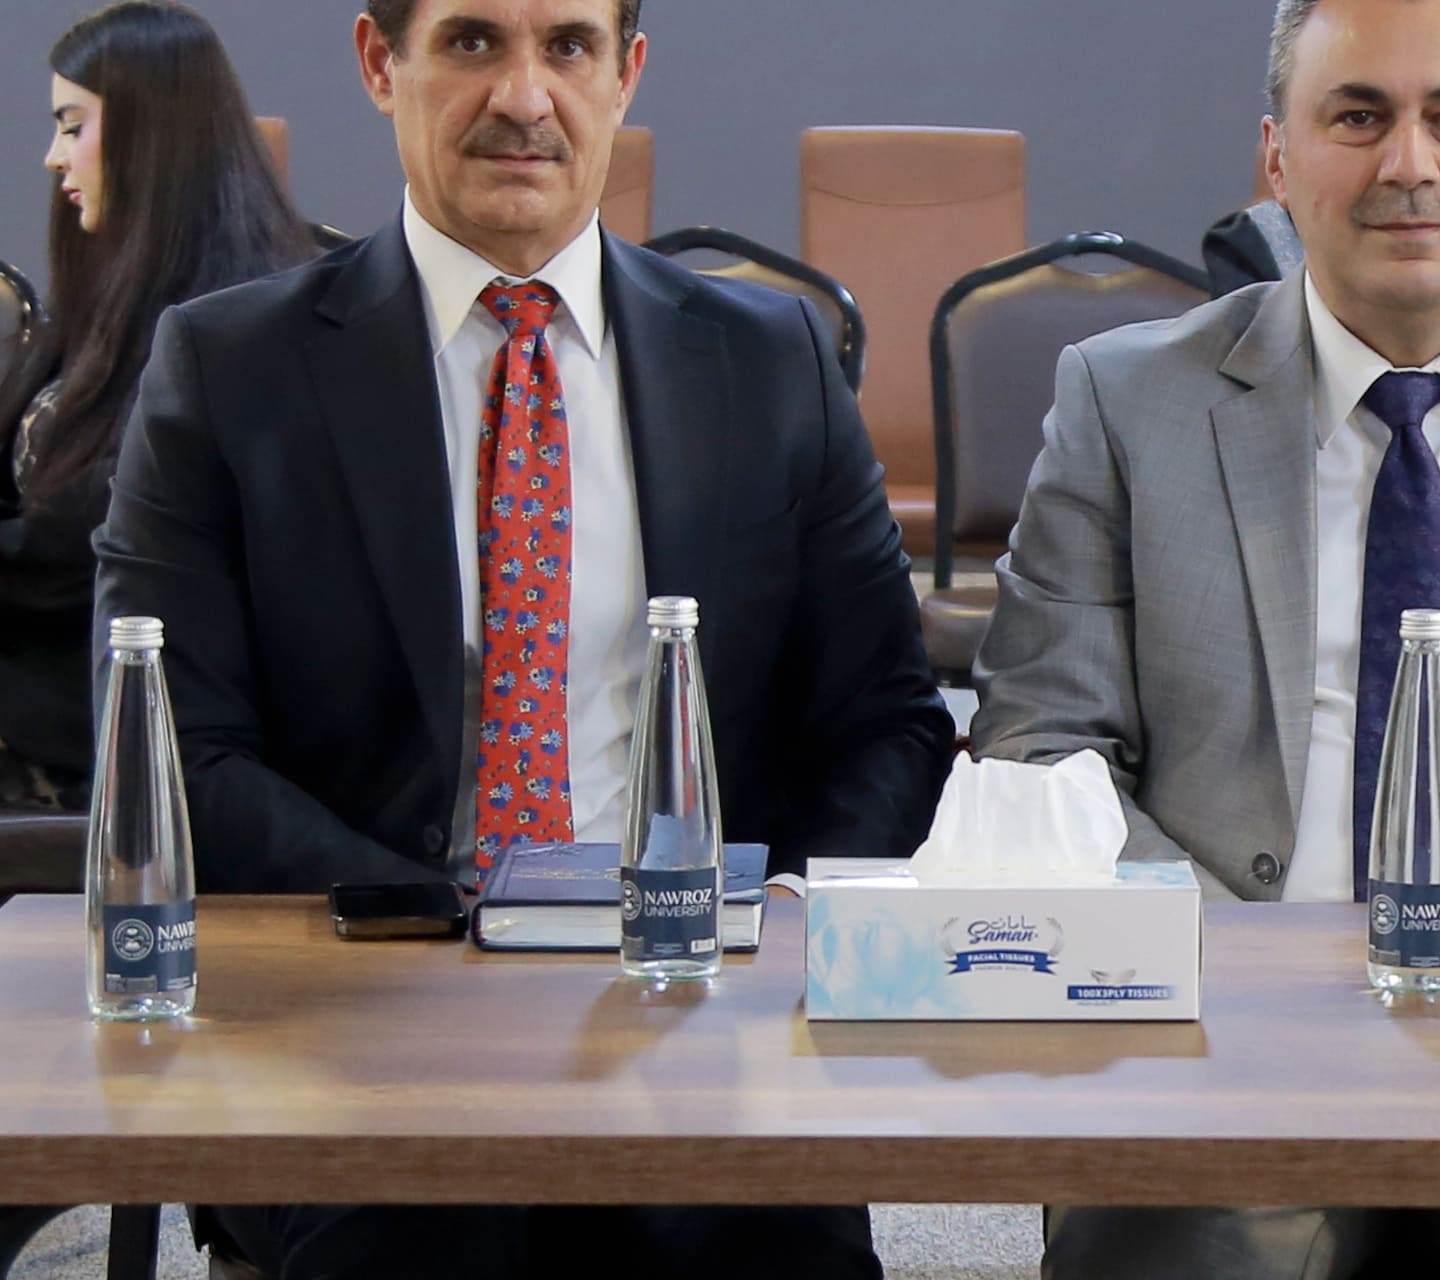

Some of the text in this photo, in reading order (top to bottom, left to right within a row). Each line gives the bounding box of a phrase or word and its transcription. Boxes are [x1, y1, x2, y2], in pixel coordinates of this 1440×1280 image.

[645, 888, 712, 906] NAWROZ
[645, 904, 712, 918] UNIVERSITY
[967, 952, 1036, 963] FACIAL TISSUES
[1127, 987, 1168, 999] TISSUES
